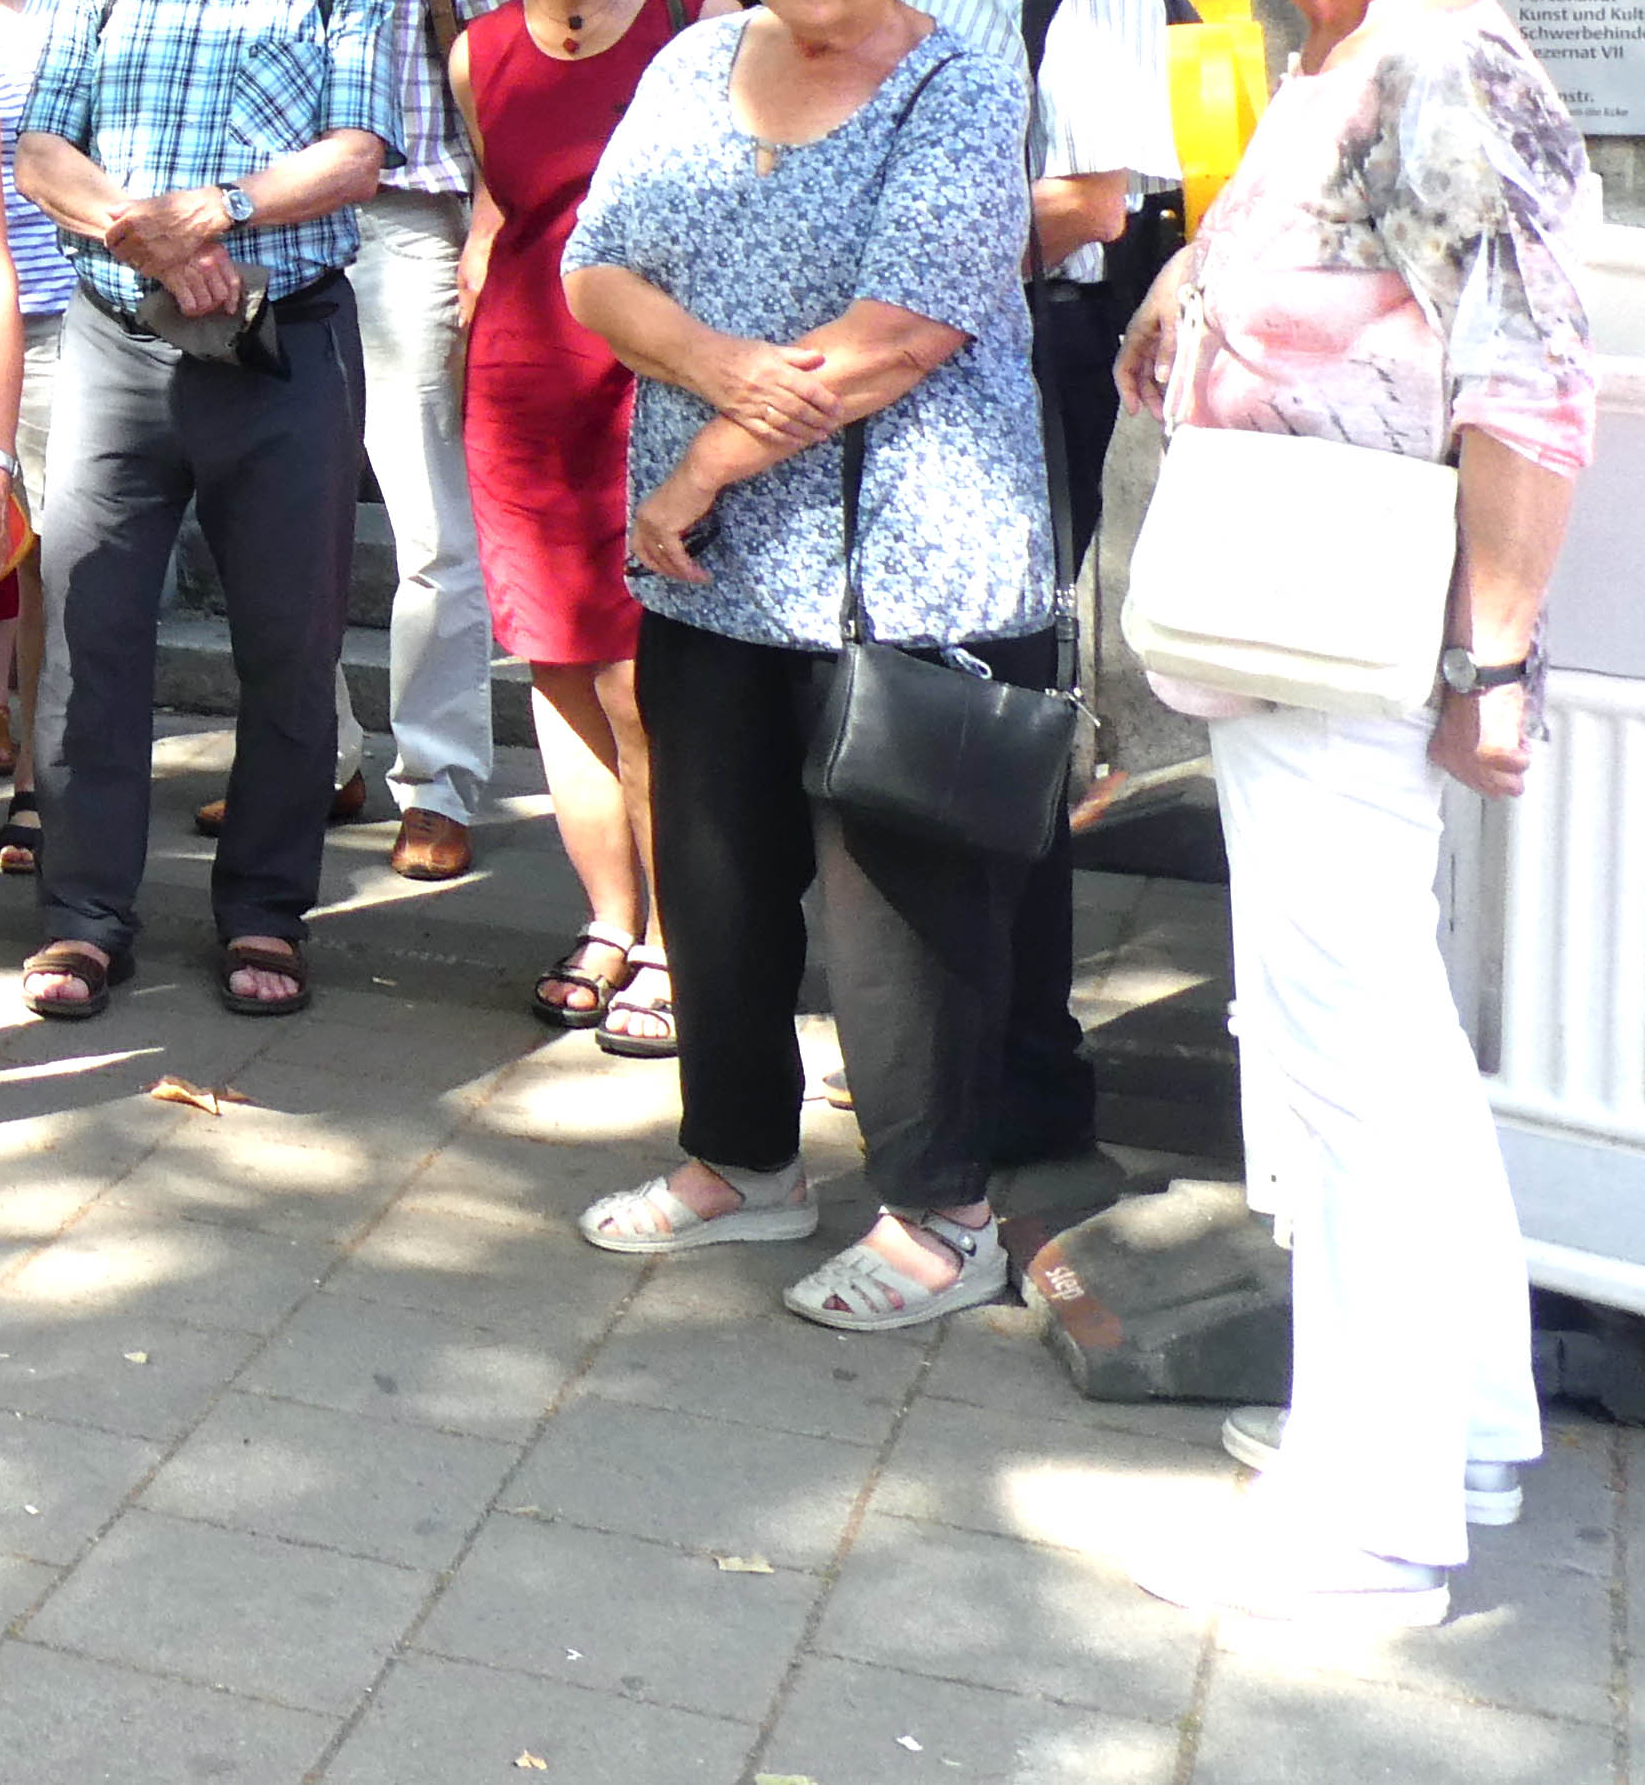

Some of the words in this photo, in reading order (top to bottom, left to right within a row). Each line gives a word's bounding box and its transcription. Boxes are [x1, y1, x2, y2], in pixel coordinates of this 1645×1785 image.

[1519, 7, 1569, 21] Kunst
[1572, 7, 1606, 21] und
[1533, 46, 1597, 59] ezernat
[1601, 46, 1624, 59] VII
